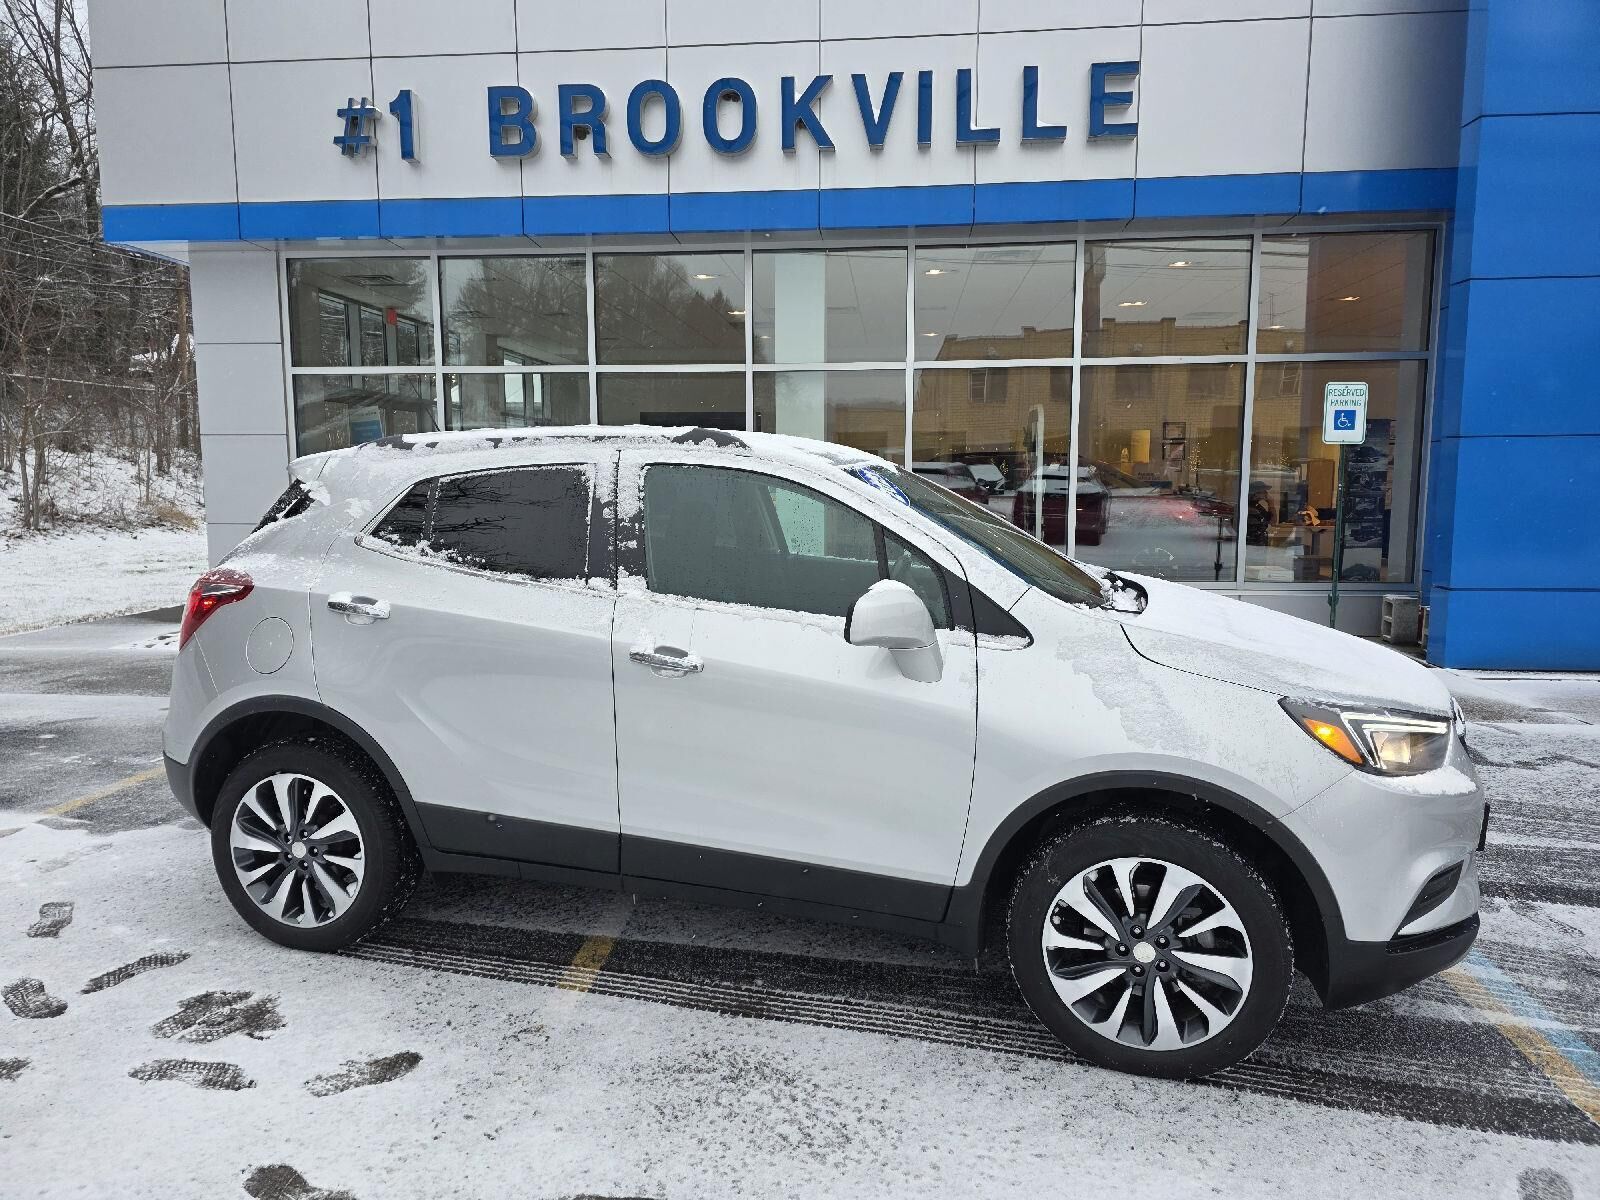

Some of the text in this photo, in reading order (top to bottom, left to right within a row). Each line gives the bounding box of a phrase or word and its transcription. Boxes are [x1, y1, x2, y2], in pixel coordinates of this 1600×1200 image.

[333, 61, 1140, 164] #1 BROOKVILLE
[1328, 388, 1365, 397] RESERVED
[1330, 399, 1362, 407] PARKING
